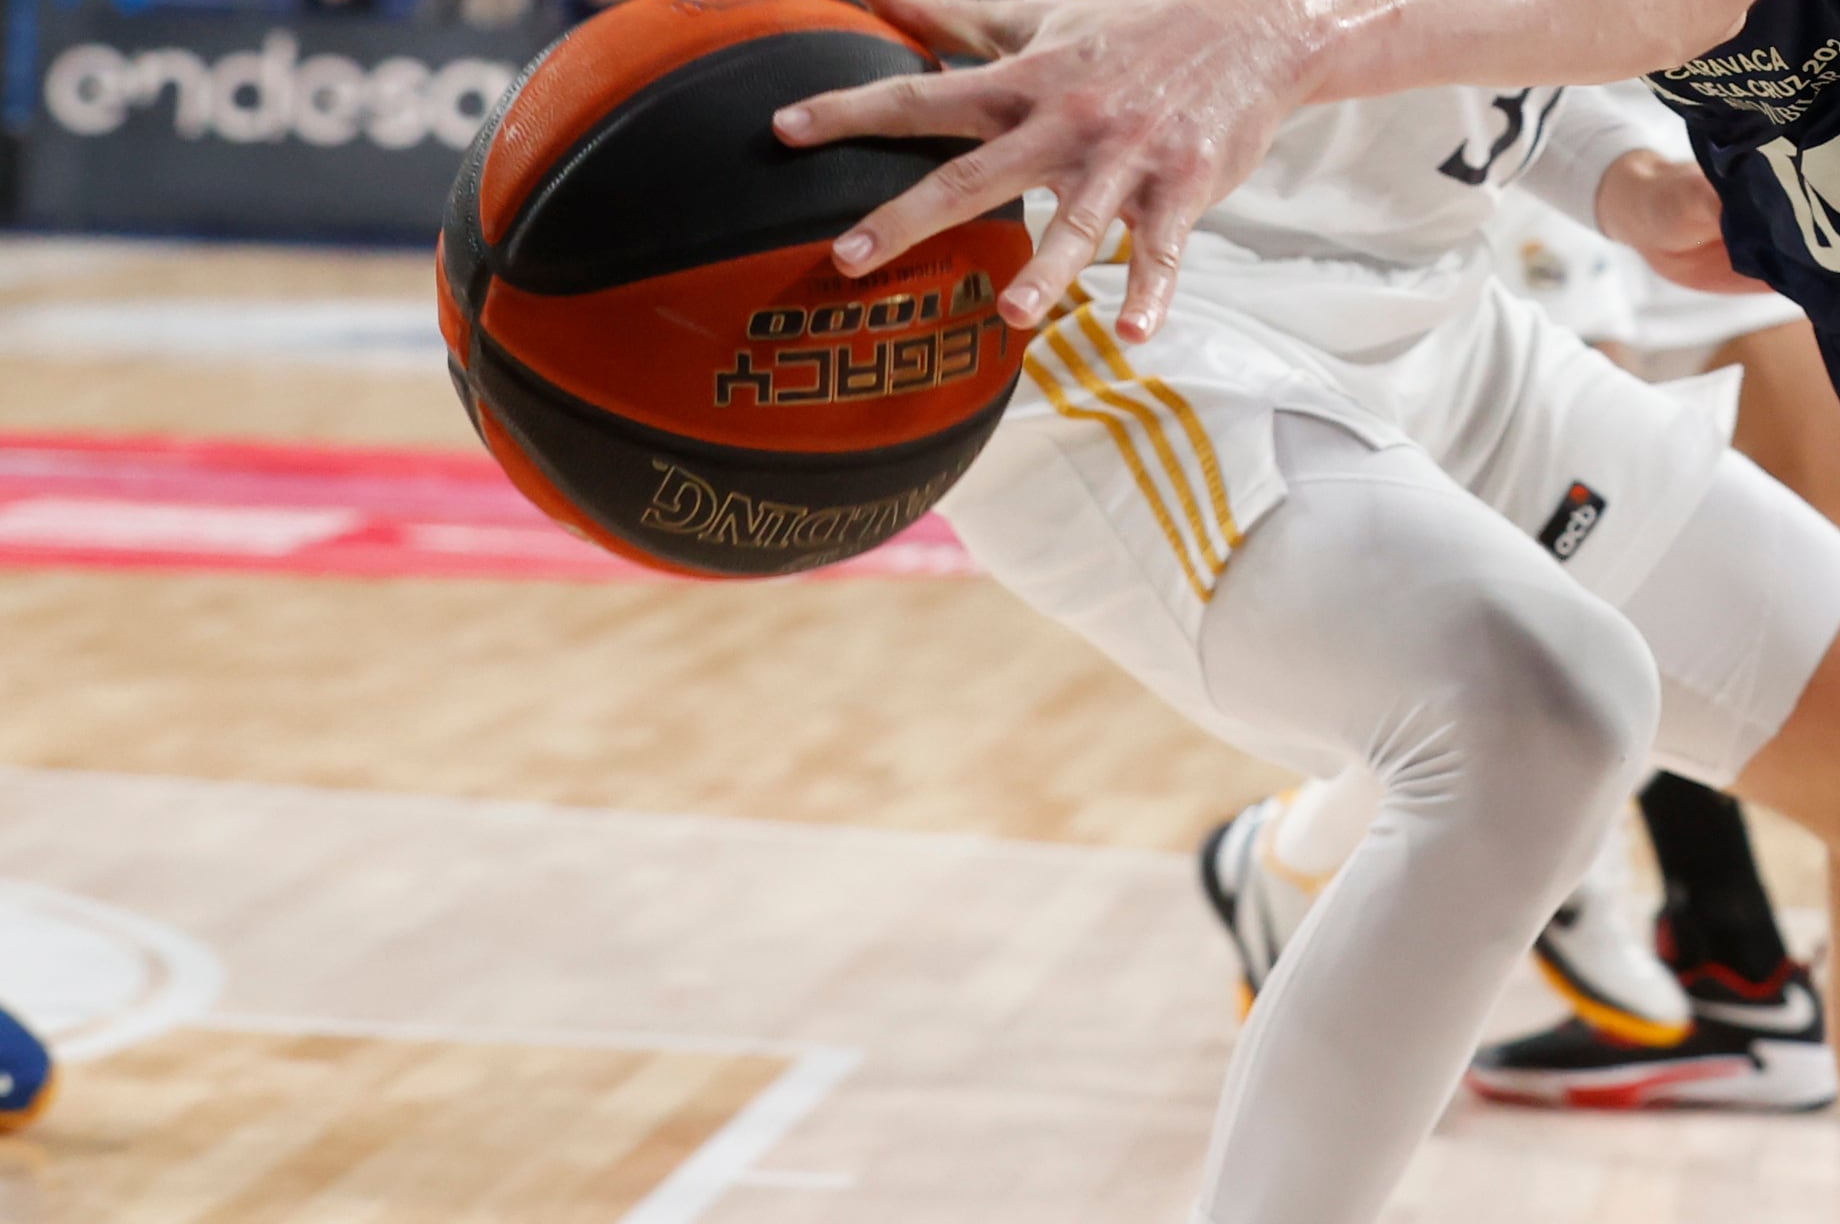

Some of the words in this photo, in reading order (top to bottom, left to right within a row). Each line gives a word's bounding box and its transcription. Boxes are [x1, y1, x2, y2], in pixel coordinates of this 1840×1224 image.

[1664, 46, 1790, 80] CARAVACA
[1747, 75, 1810, 99] CRUZ
[44, 28, 515, 150] endesa
[747, 292, 943, 339] 1000
[640, 462, 950, 548] ALDING
[1554, 503, 1597, 556] acb
